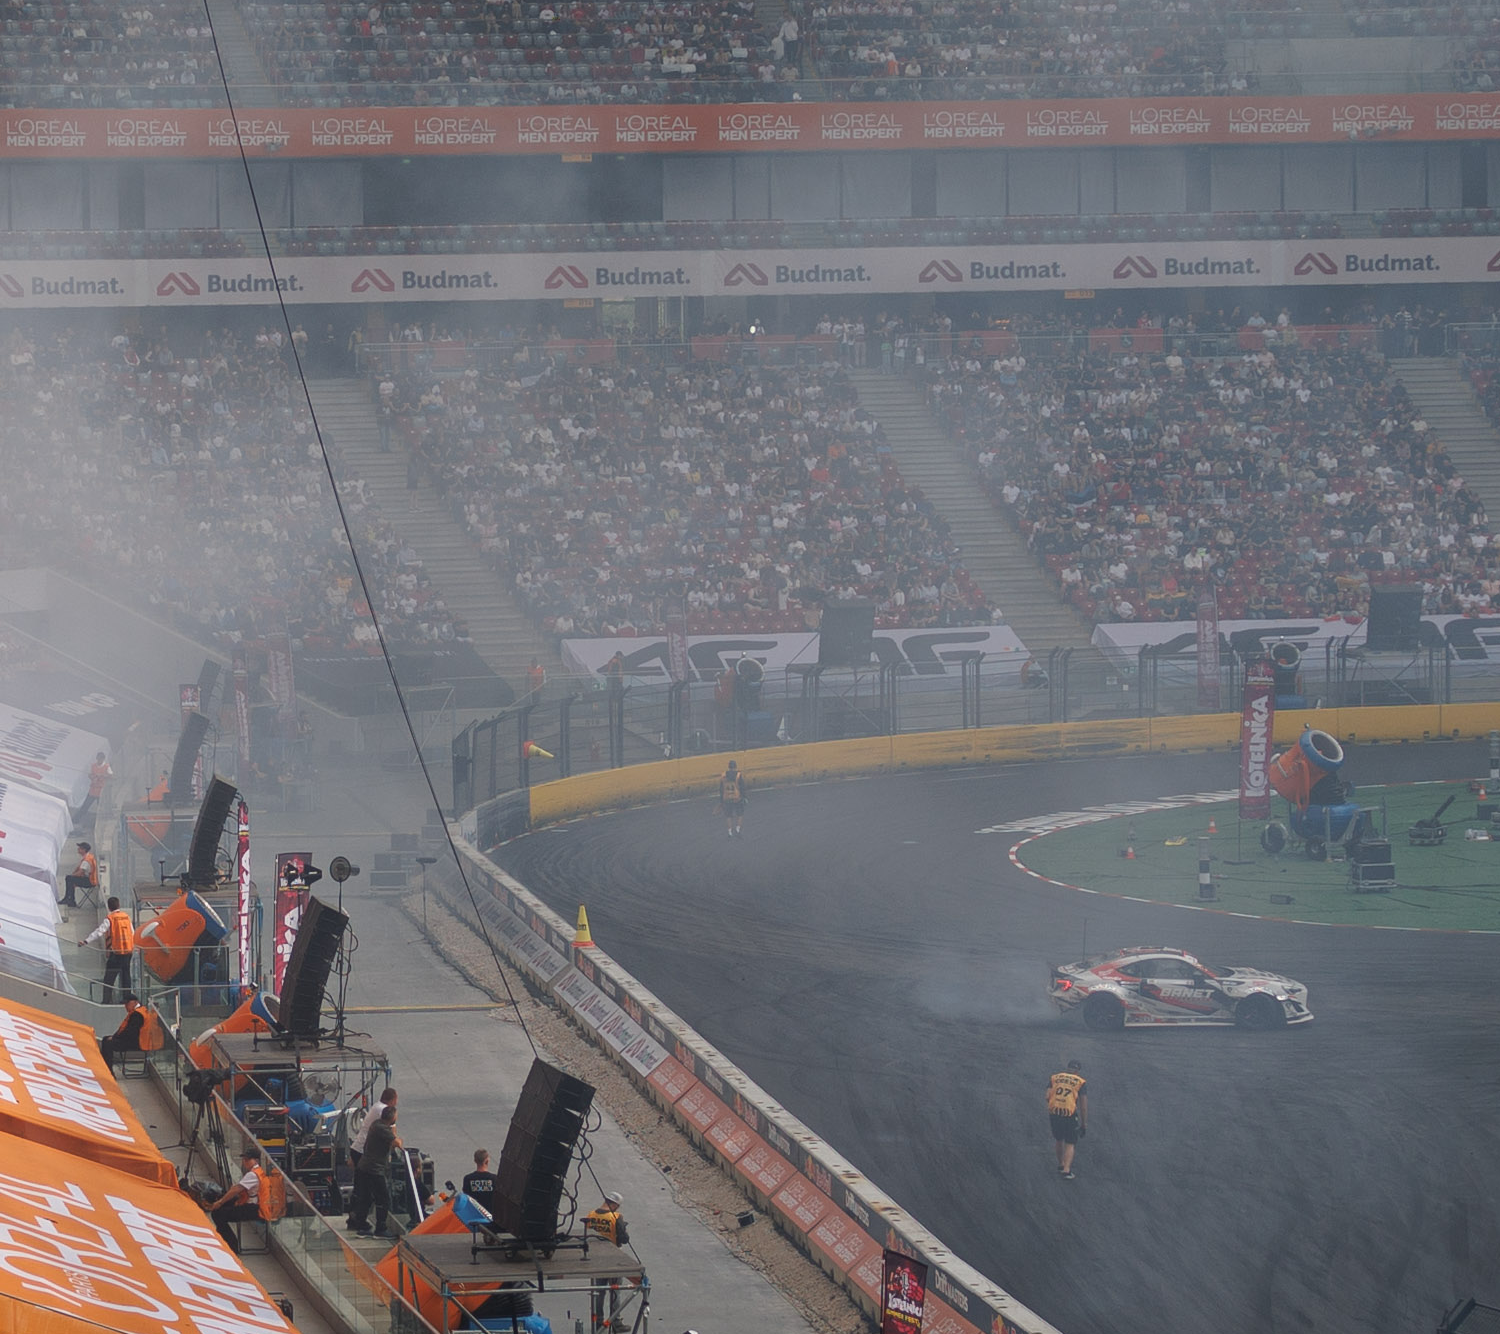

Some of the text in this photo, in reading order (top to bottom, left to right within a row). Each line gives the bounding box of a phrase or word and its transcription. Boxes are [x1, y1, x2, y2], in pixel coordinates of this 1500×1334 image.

[776, 265, 871, 283] Budmat.
[1165, 257, 1260, 275] Budmat.
[32, 277, 124, 294] Budmat.
[403, 270, 497, 289] Budmat.
[1055, 1087, 1071, 1097] 07
[105, 1194, 289, 1329] EXPERT
